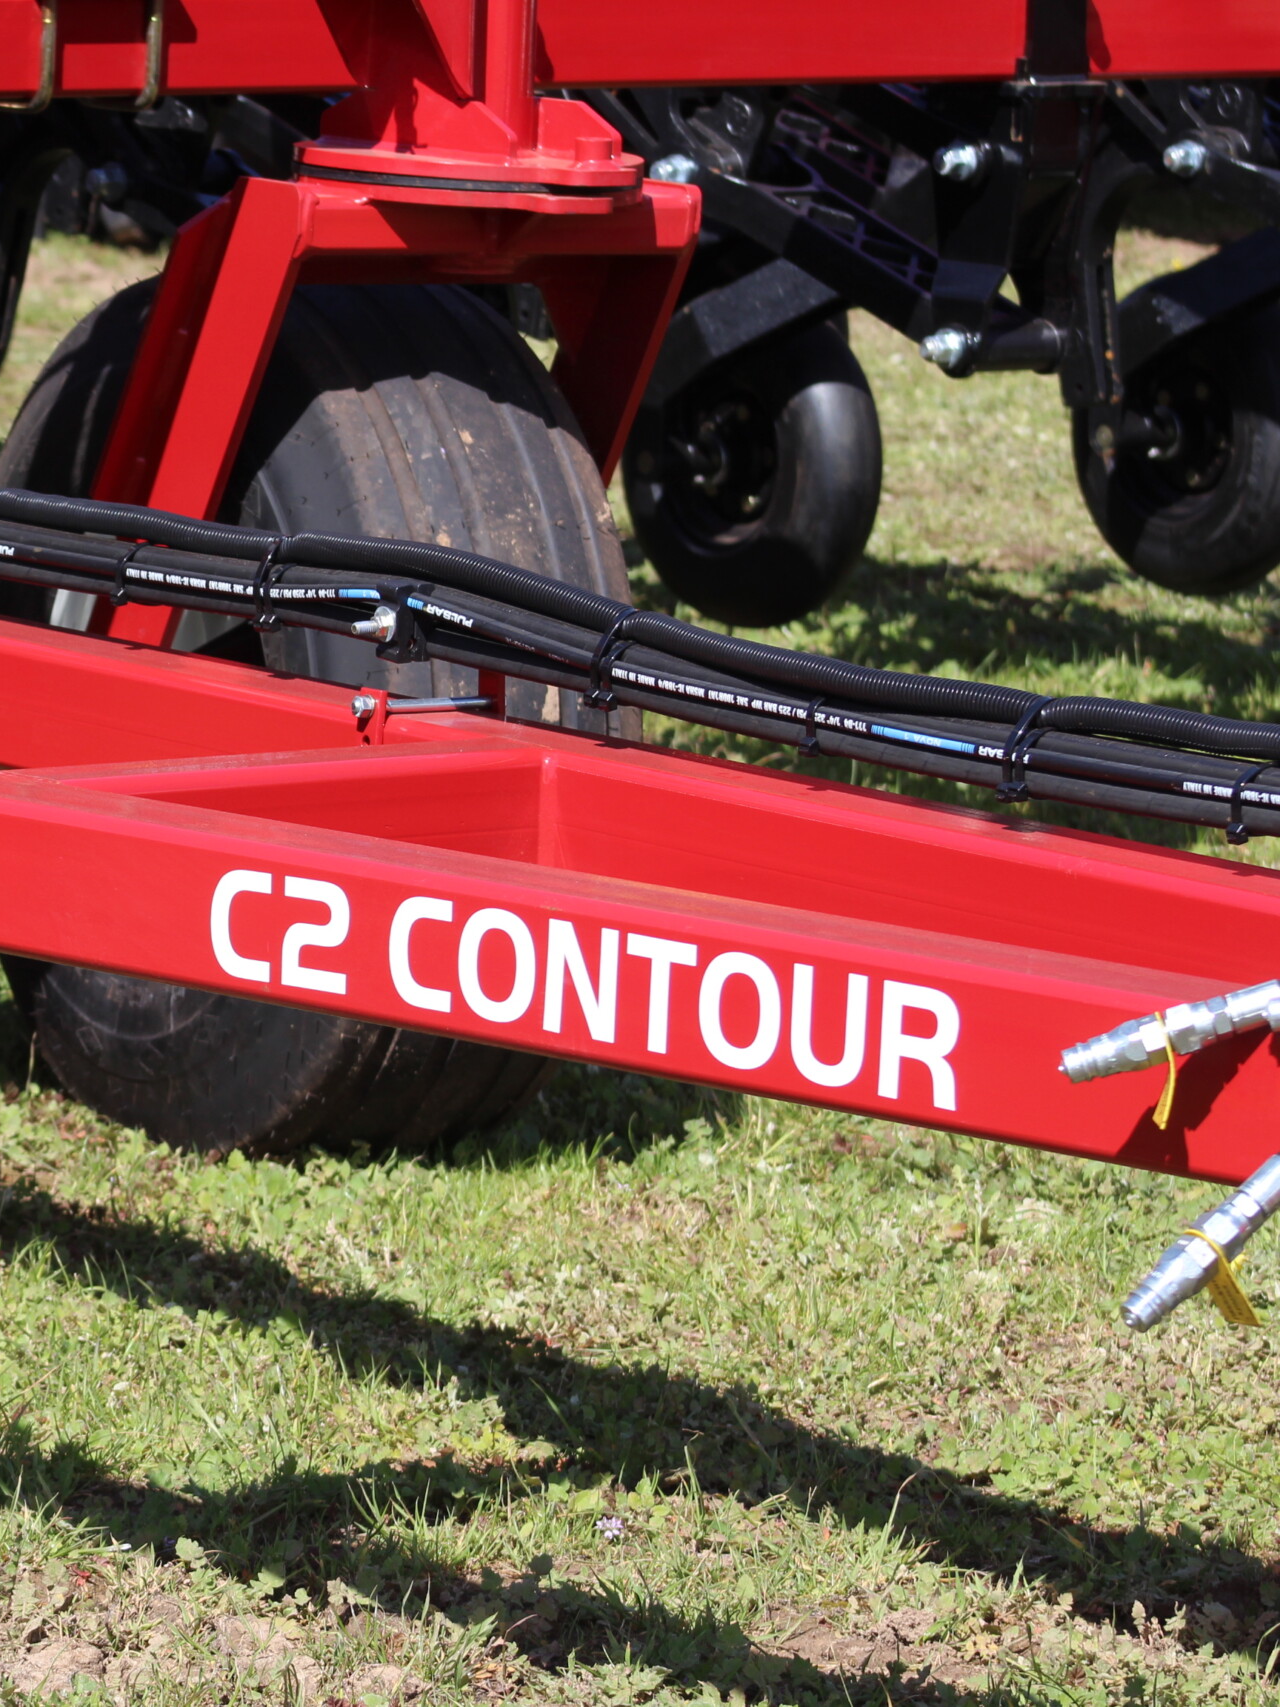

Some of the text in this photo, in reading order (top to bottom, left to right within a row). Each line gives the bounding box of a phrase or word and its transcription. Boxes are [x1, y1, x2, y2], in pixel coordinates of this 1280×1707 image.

[426, 603, 473, 628] PULSAR
[612, 667, 628, 680] ITALY
[628, 672, 636, 682] IN
[637, 673, 655, 687] MADE
[764, 701, 777, 713] BAR
[778, 705, 791, 716] 225
[844, 718, 867, 732] 111-04
[210, 869, 960, 1111] C2 CONTOUR
